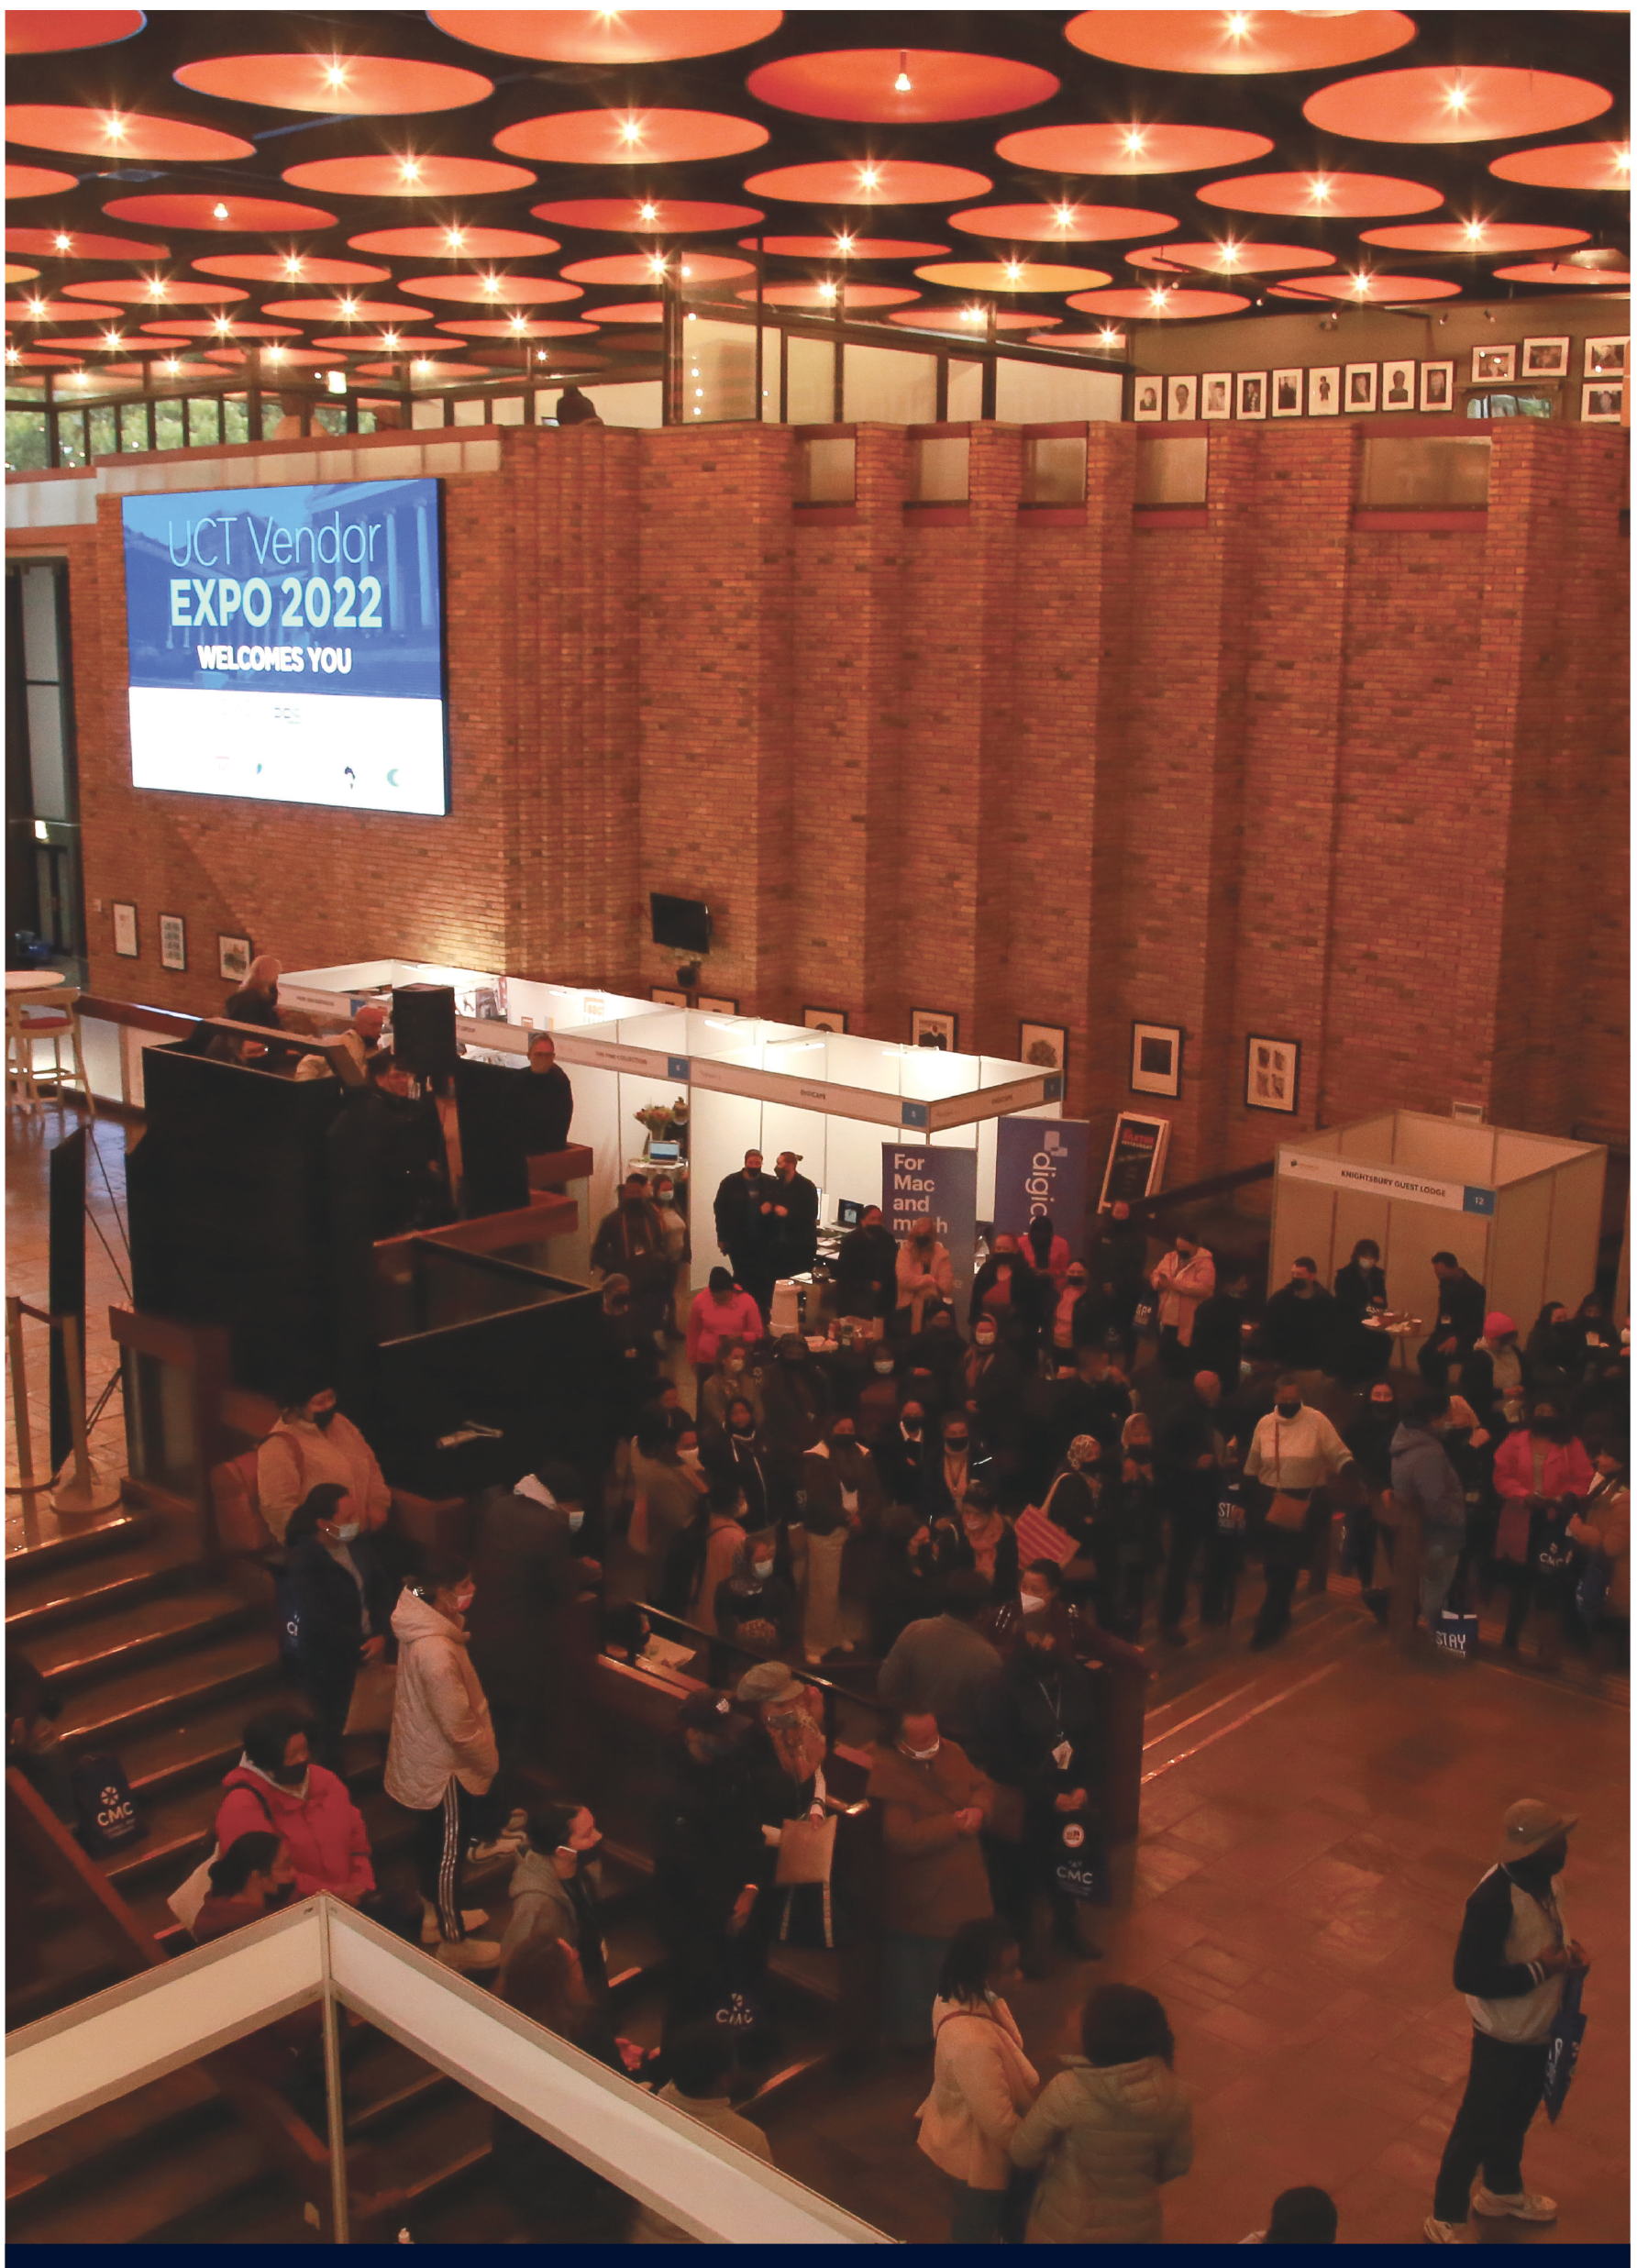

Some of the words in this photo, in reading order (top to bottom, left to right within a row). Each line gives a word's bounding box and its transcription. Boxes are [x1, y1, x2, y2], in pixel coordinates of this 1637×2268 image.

[169, 517, 238, 567] UCT
[248, 511, 382, 565] Vendor
[170, 577, 272, 627] EXPO
[281, 576, 383, 627] 2022
[196, 645, 305, 672] WELCOMES
[306, 647, 353, 674] YOU
[893, 1153, 925, 1171] For
[893, 1174, 936, 1192] Mac
[1341, 1170, 1393, 1186] KNIGHTSBURY
[1394, 1180, 1419, 1191] GUEST
[1420, 1186, 1446, 1197] LODGE
[892, 1195, 931, 1212] and
[1475, 1196, 1485, 1206] 12
[892, 1216, 949, 1234] mh
[1435, 1631, 1466, 1651] STAY
[97, 1801, 135, 1827] CMC
[1056, 1865, 1094, 1885] CMC
